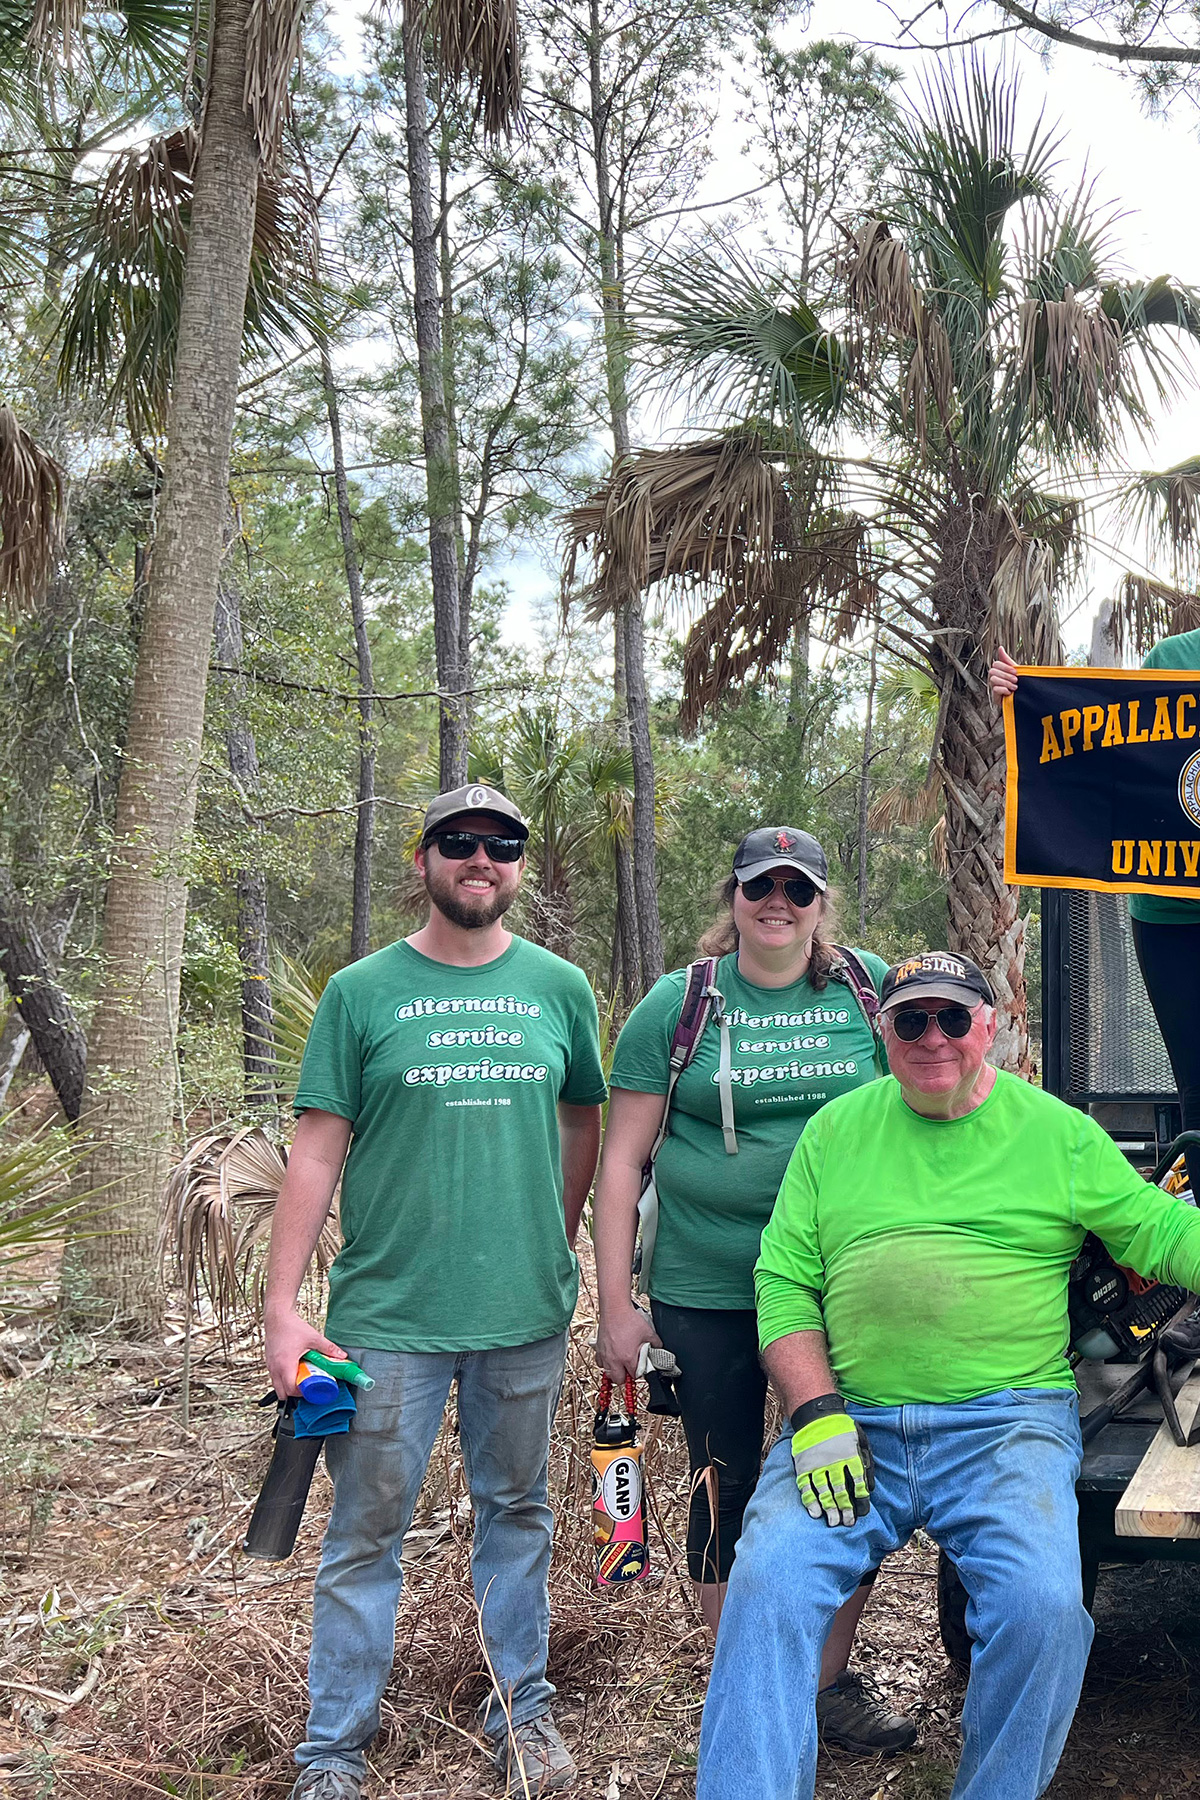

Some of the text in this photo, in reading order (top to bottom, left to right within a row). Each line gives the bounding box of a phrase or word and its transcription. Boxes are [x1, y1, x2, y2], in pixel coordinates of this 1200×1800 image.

[922, 957, 966, 980] STATE
[397, 996, 542, 1020] alternative
[427, 1025, 523, 1047] service
[737, 1035, 830, 1053] service
[404, 1059, 548, 1085] experience
[445, 1098, 511, 1107] established 1988
[755, 1092, 826, 1104] established 1988
[1092, 1280, 1115, 1302] ECHO
[615, 1462, 630, 1517] GANP
